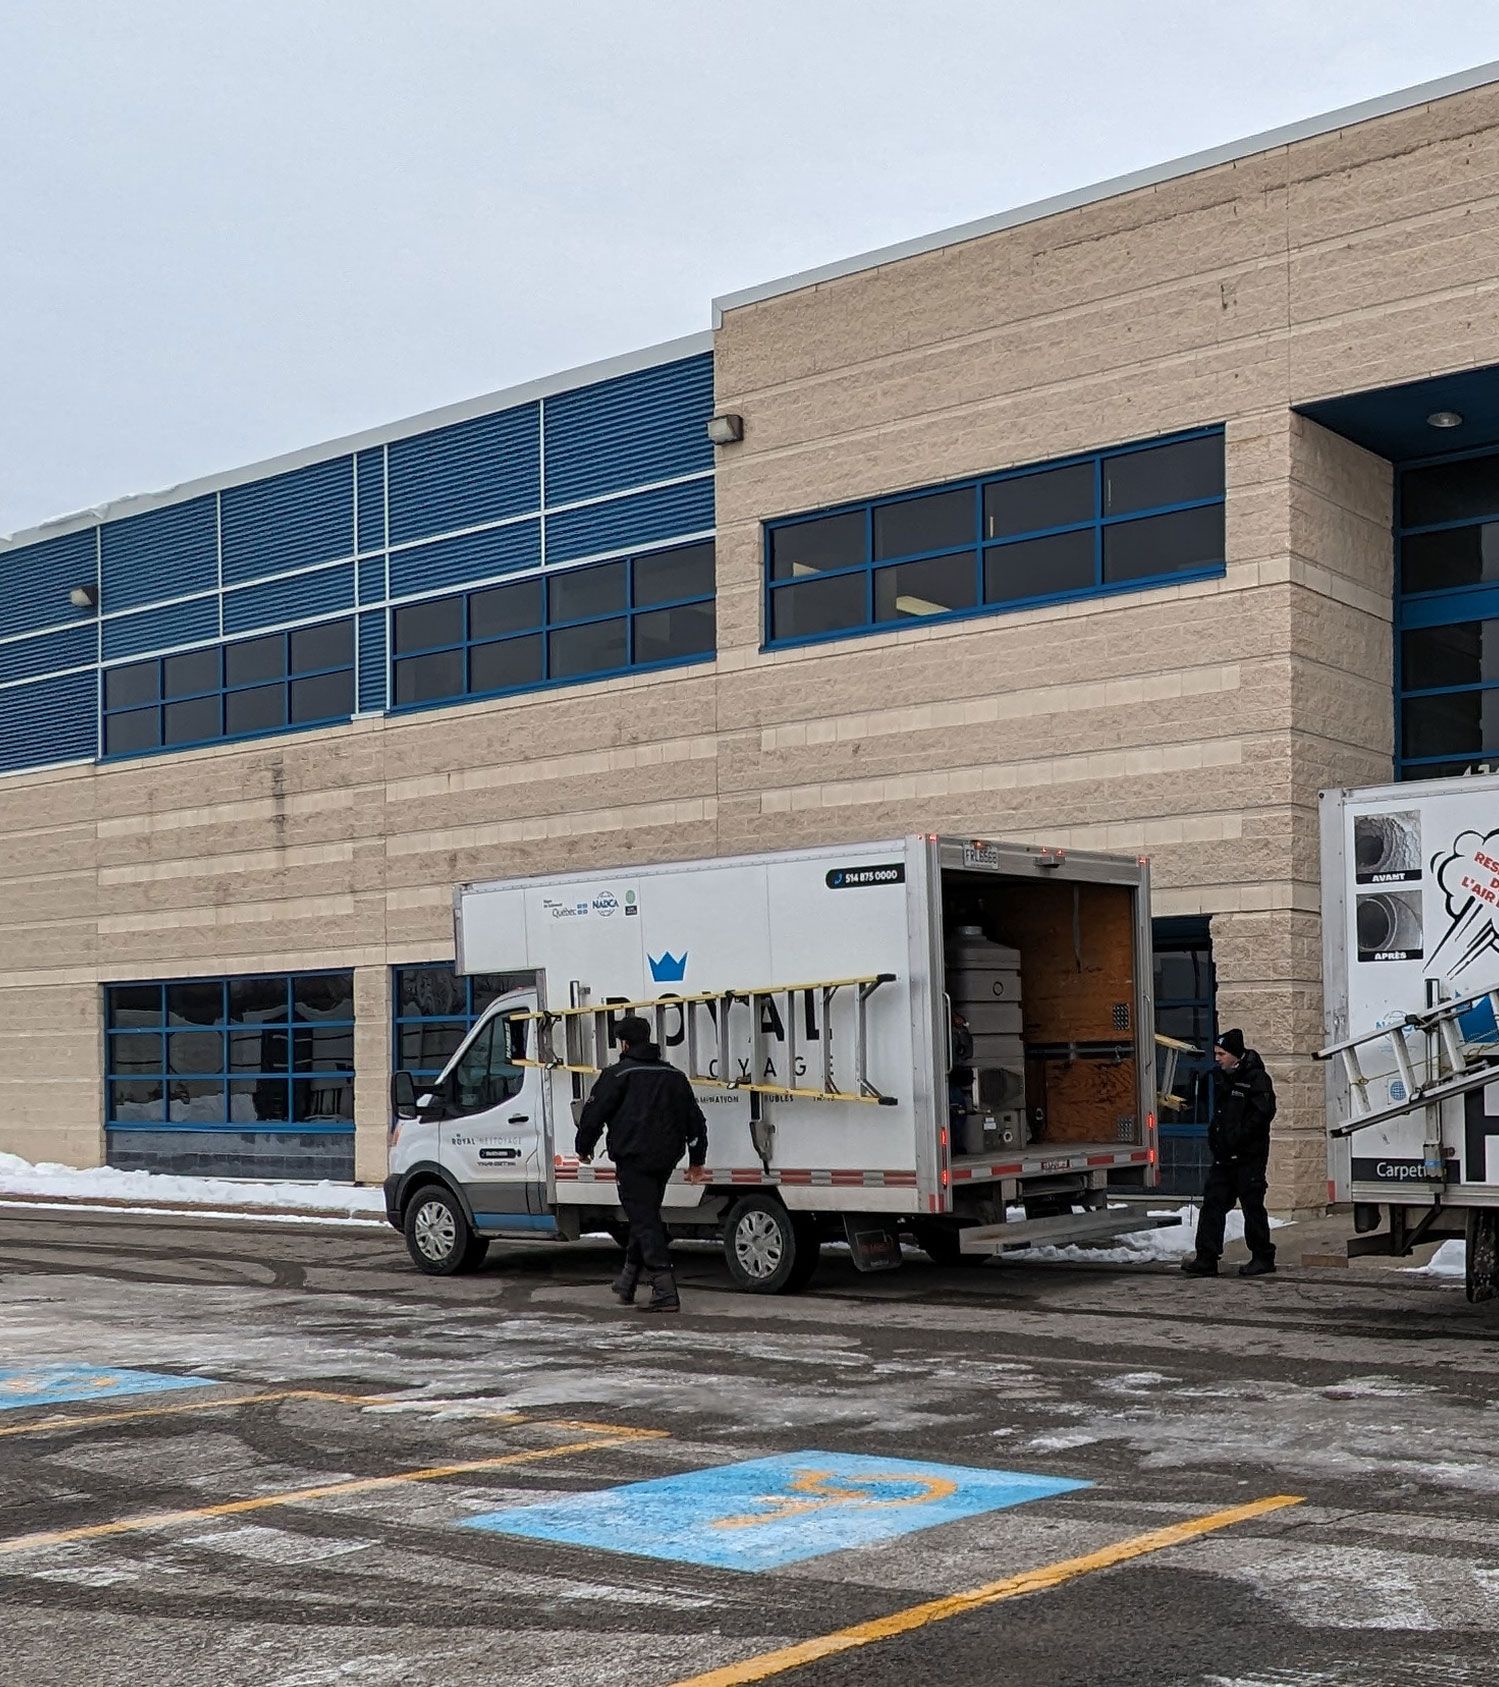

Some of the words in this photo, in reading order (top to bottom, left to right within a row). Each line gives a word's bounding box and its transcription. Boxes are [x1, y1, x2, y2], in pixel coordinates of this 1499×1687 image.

[845, 874, 859, 883] 514
[875, 869, 897, 880] 0000
[1371, 873, 1406, 882] AVANT
[1461, 876, 1496, 903] L'AIR
[1374, 951, 1407, 961] APRÈS
